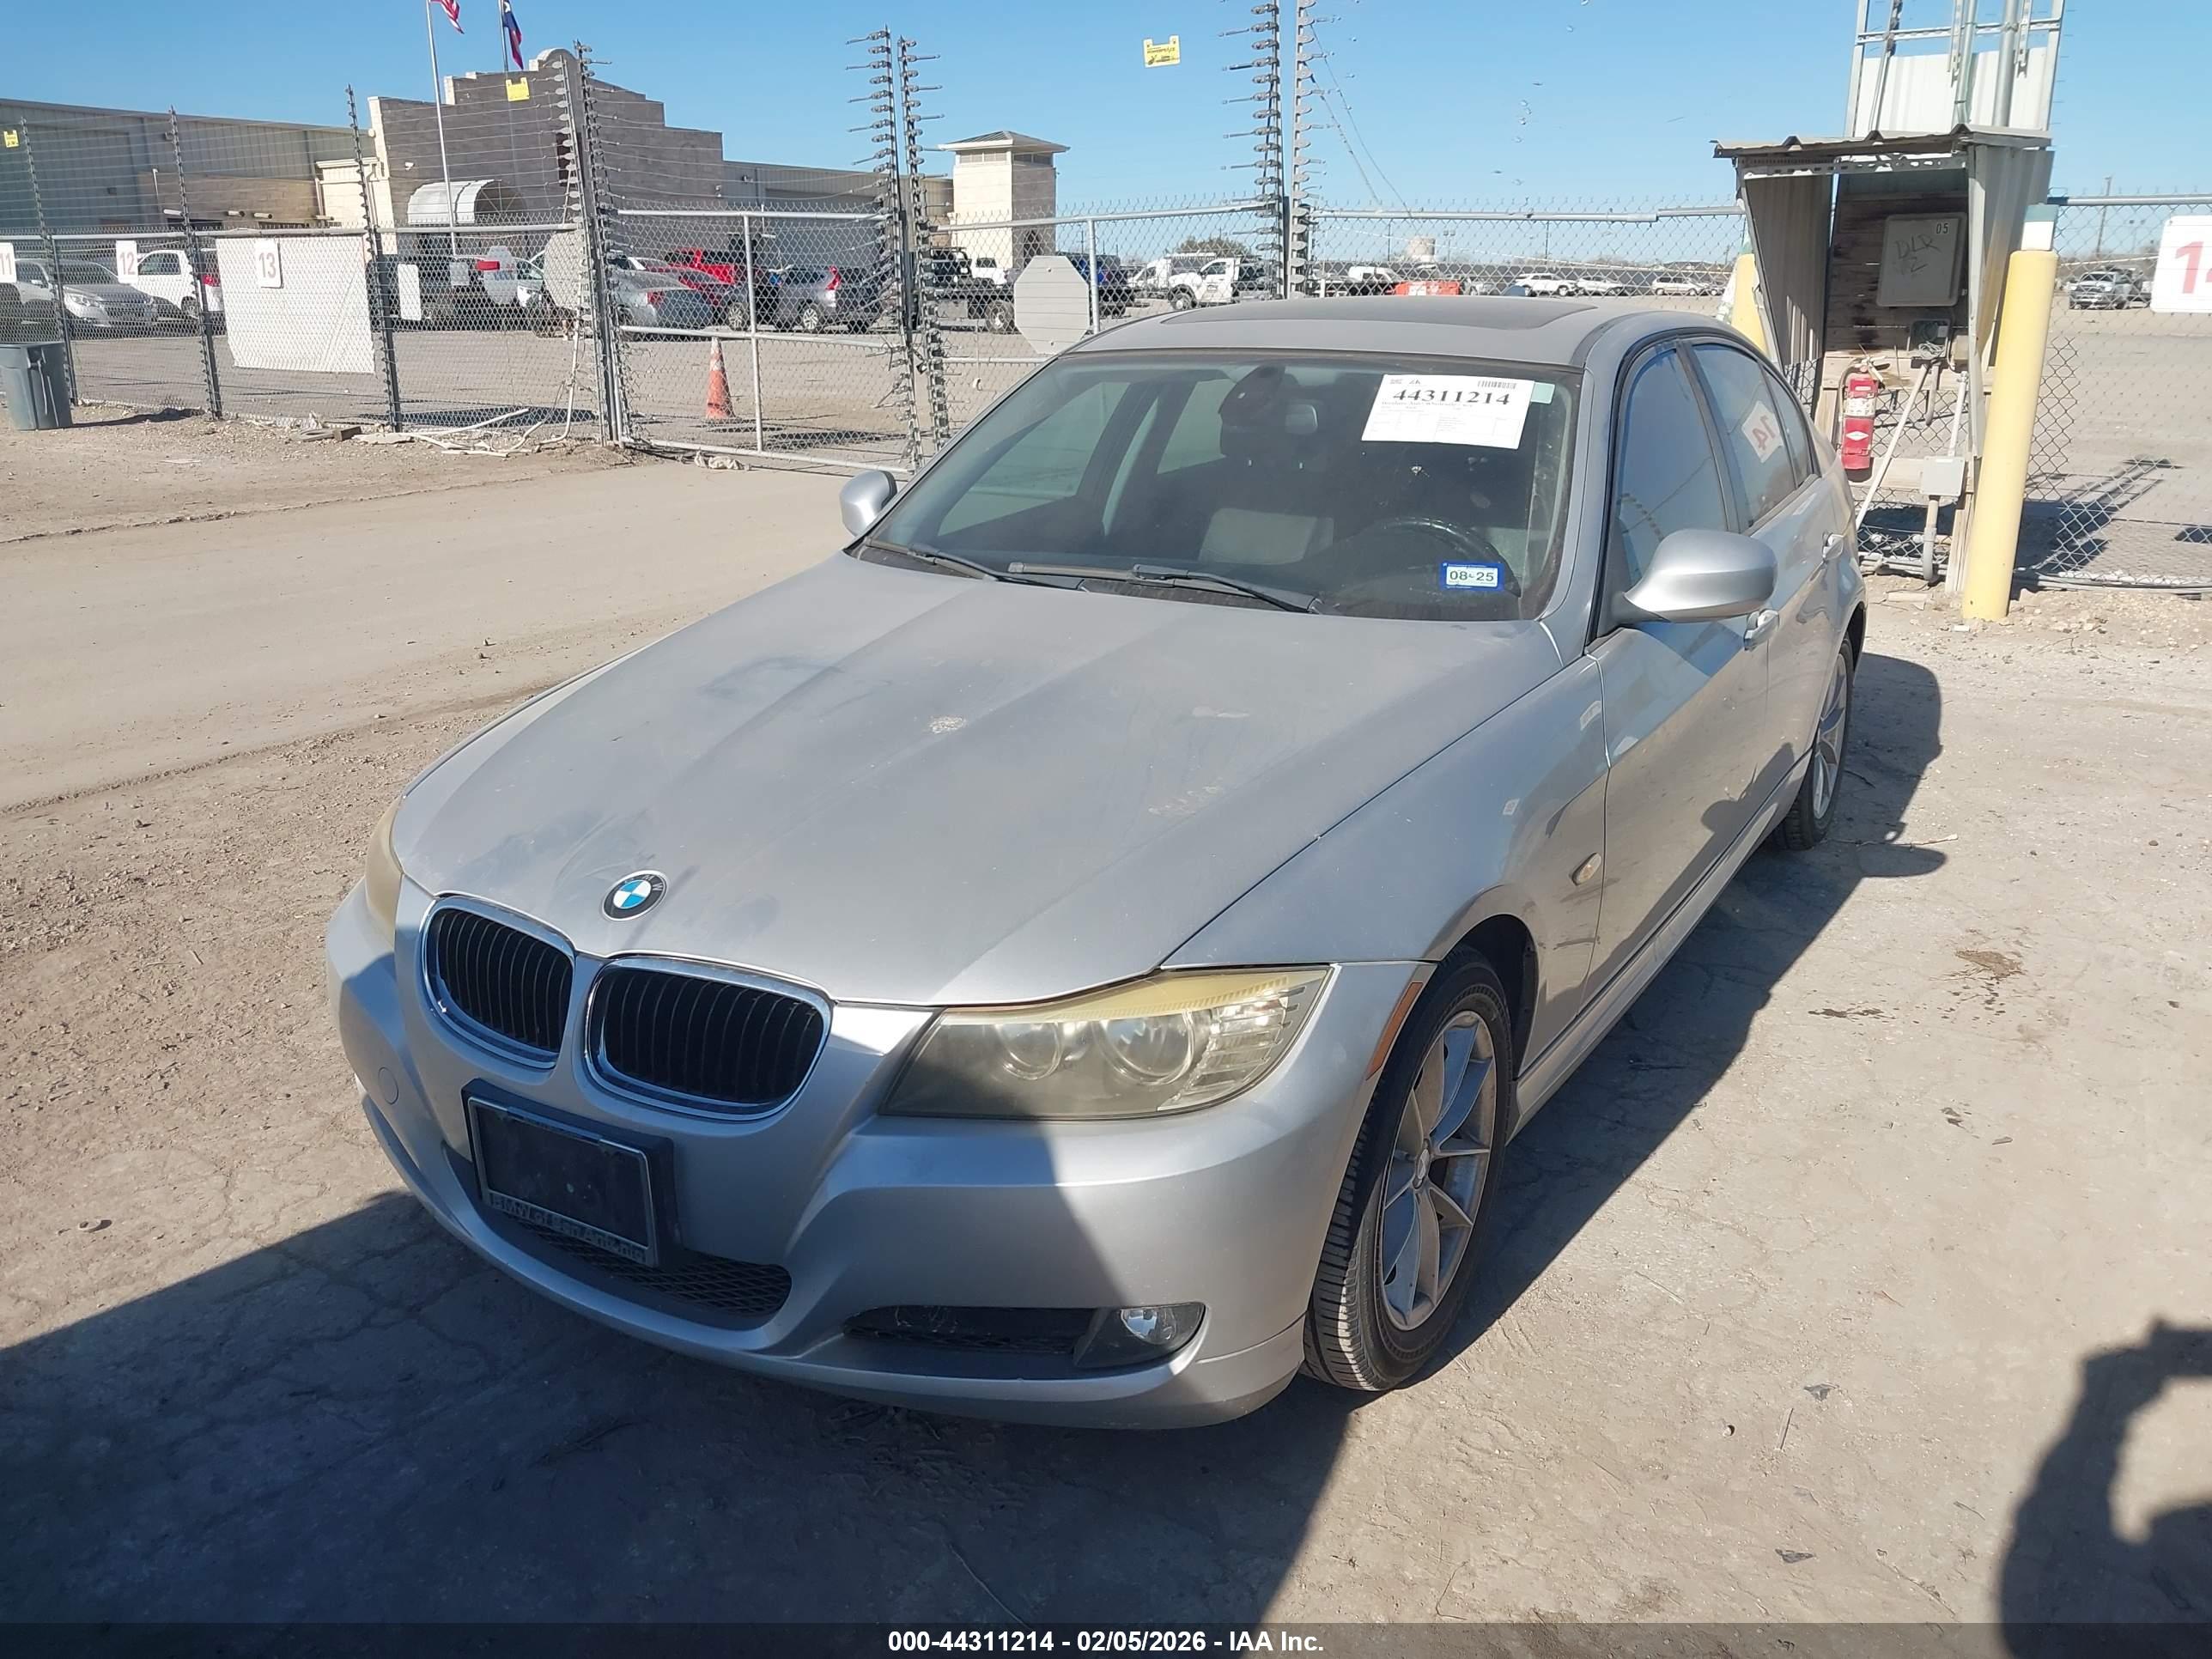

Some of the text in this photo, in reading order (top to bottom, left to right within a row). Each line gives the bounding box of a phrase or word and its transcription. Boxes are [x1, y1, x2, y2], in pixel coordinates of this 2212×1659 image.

[1936, 222, 1949, 234] 05
[119, 252, 136, 276] 12
[258, 252, 276, 279] 13
[2174, 240, 2212, 295] 1
[1393, 389, 1510, 405] 44311214
